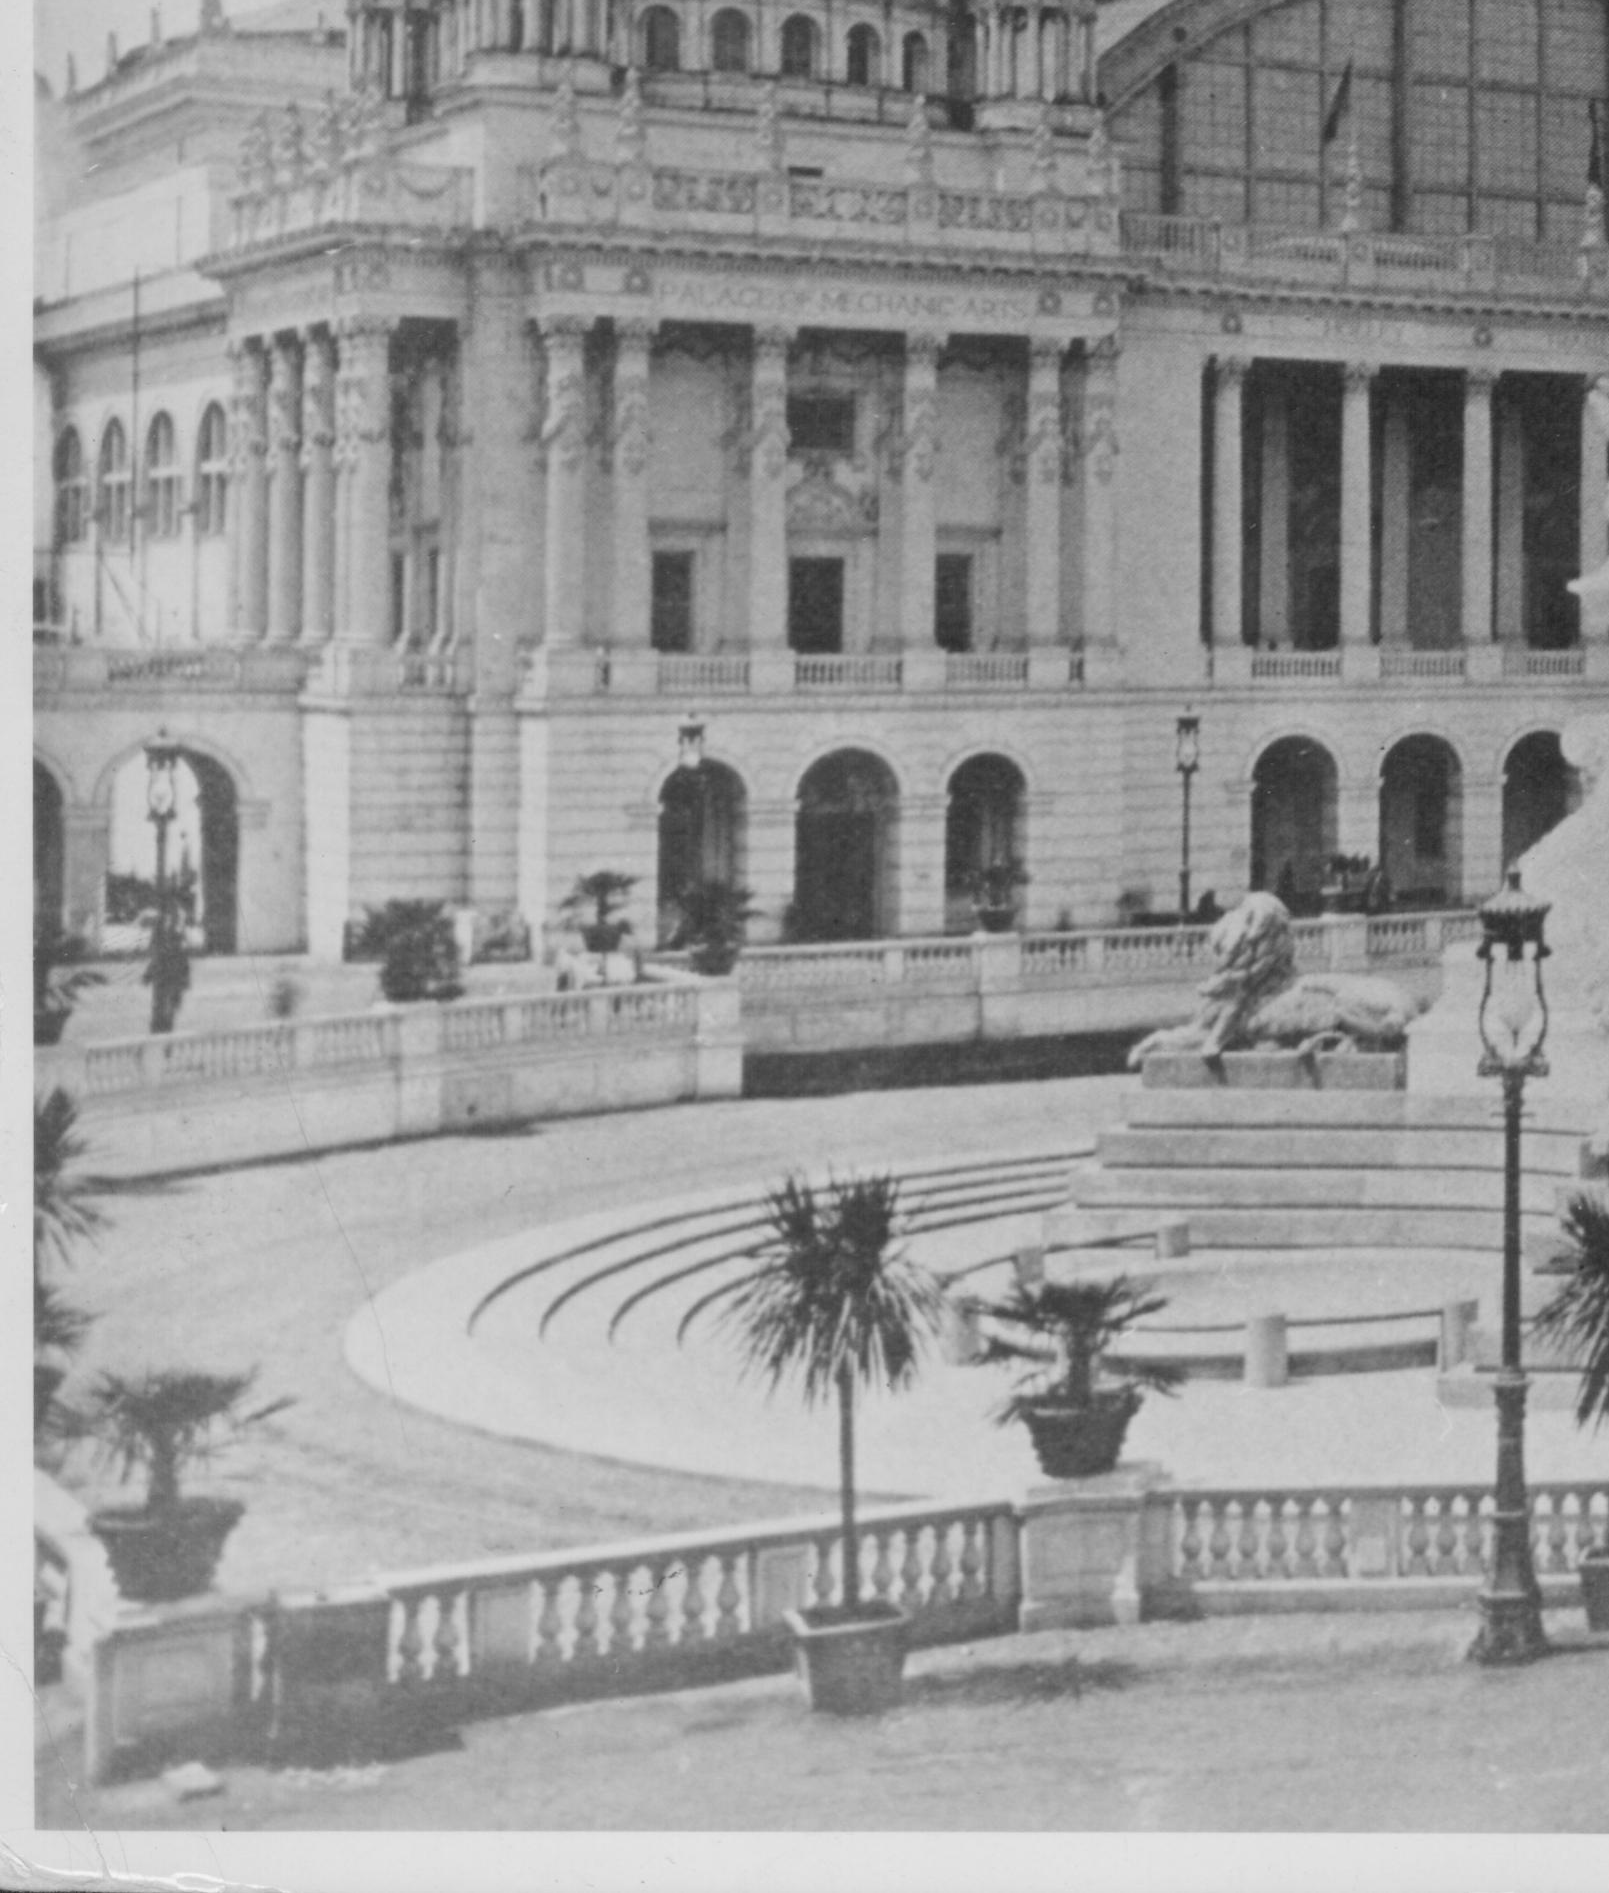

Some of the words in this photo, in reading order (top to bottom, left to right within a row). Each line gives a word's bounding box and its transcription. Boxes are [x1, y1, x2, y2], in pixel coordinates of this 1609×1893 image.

[658, 283, 772, 309] PALACE
[820, 289, 954, 317] MECHANIC
[962, 297, 1029, 321] ARTS
